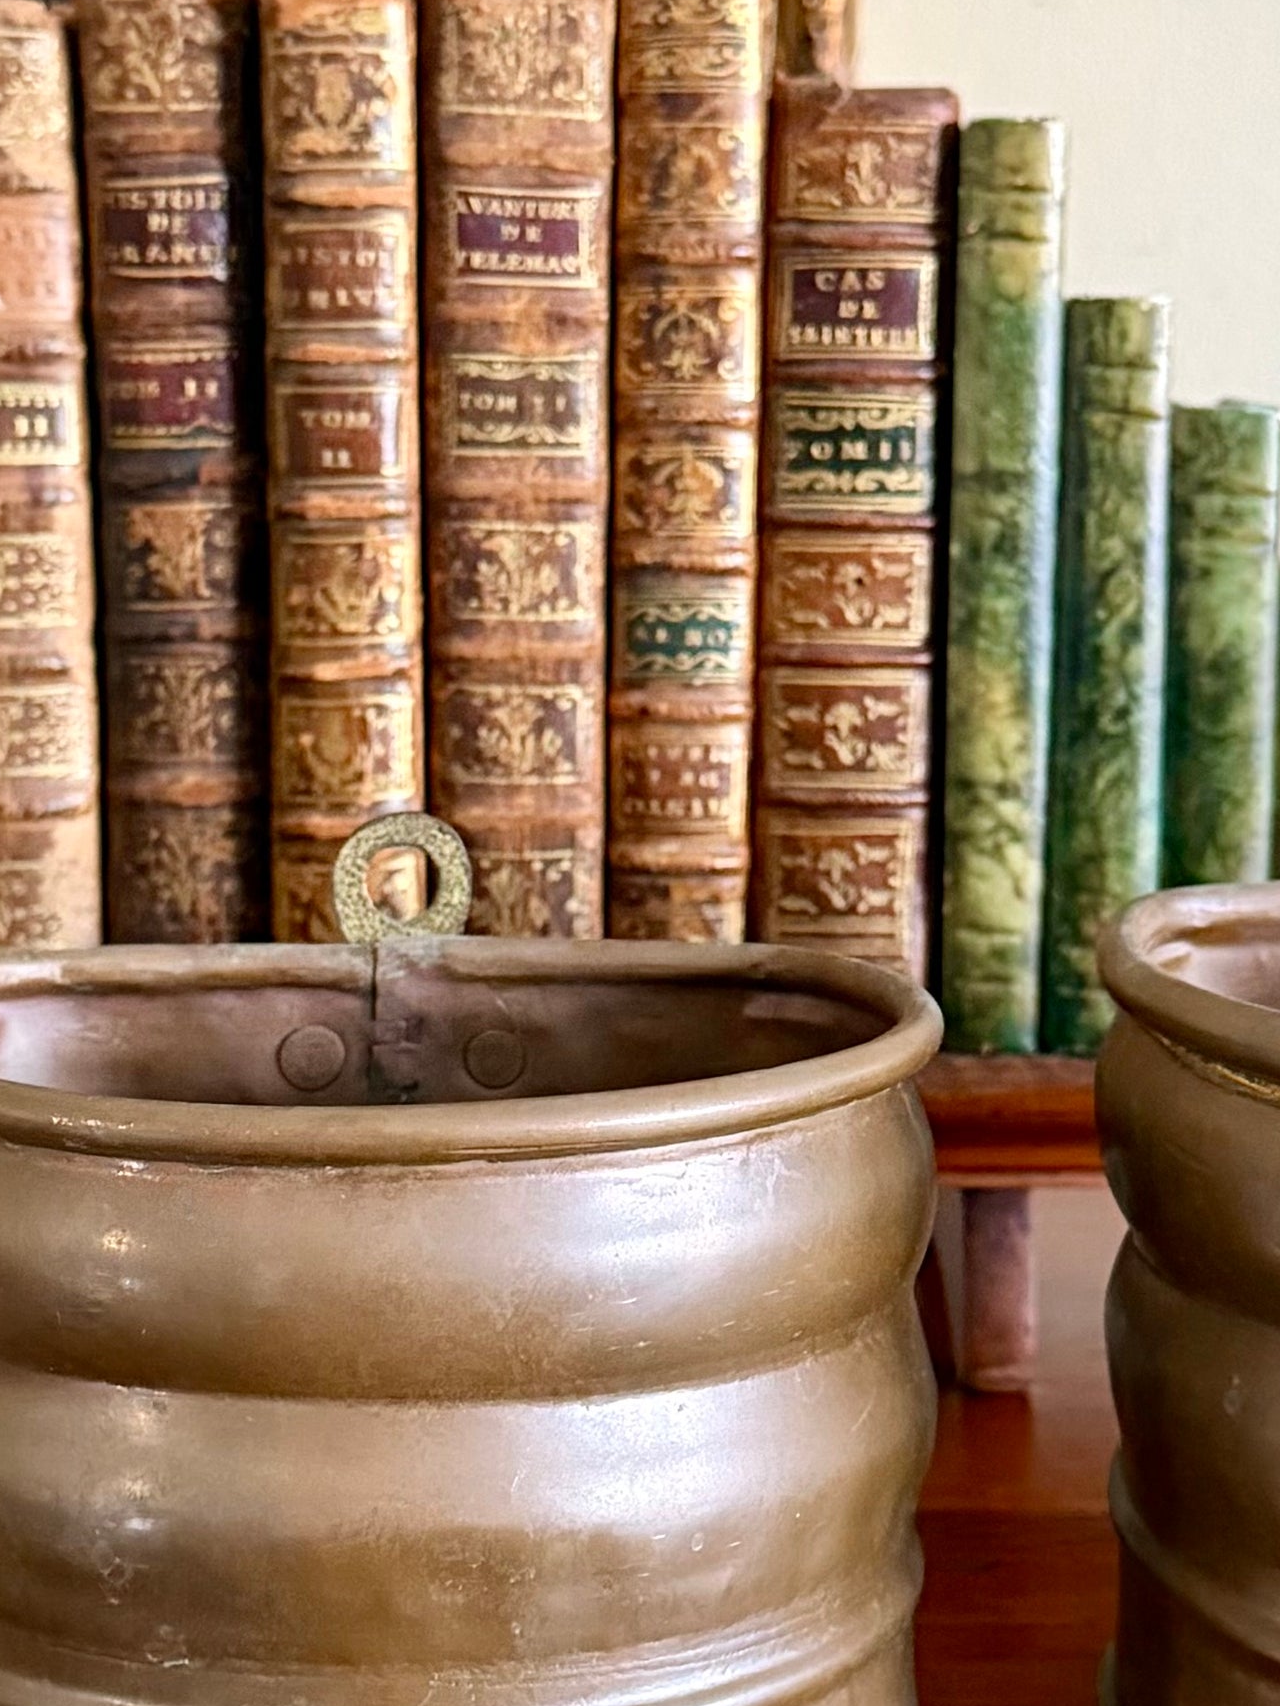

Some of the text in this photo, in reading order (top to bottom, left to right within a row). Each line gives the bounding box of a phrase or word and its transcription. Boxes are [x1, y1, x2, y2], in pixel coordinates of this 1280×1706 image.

[499, 223, 542, 244] DE
[814, 269, 887, 293] CAS
[300, 409, 372, 430] TOM
